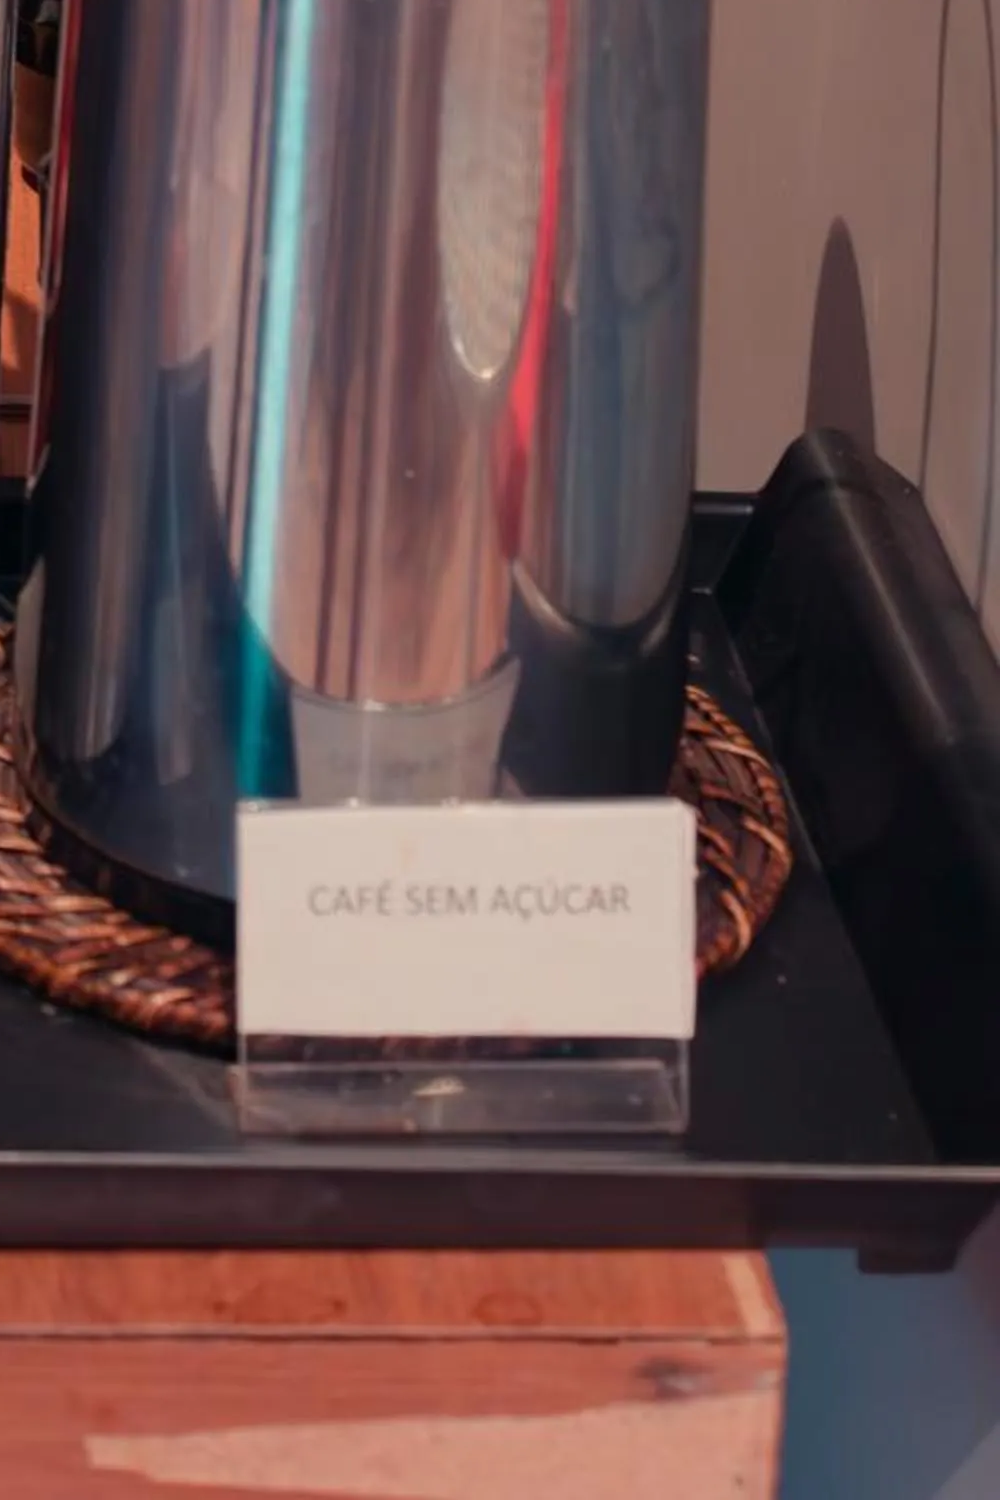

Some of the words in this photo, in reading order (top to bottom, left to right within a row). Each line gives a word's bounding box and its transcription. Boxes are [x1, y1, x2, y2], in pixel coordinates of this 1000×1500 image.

[306, 878, 393, 917] CAFÉ
[405, 884, 479, 916] SEM
[488, 878, 632, 922] AÇÚCAR
